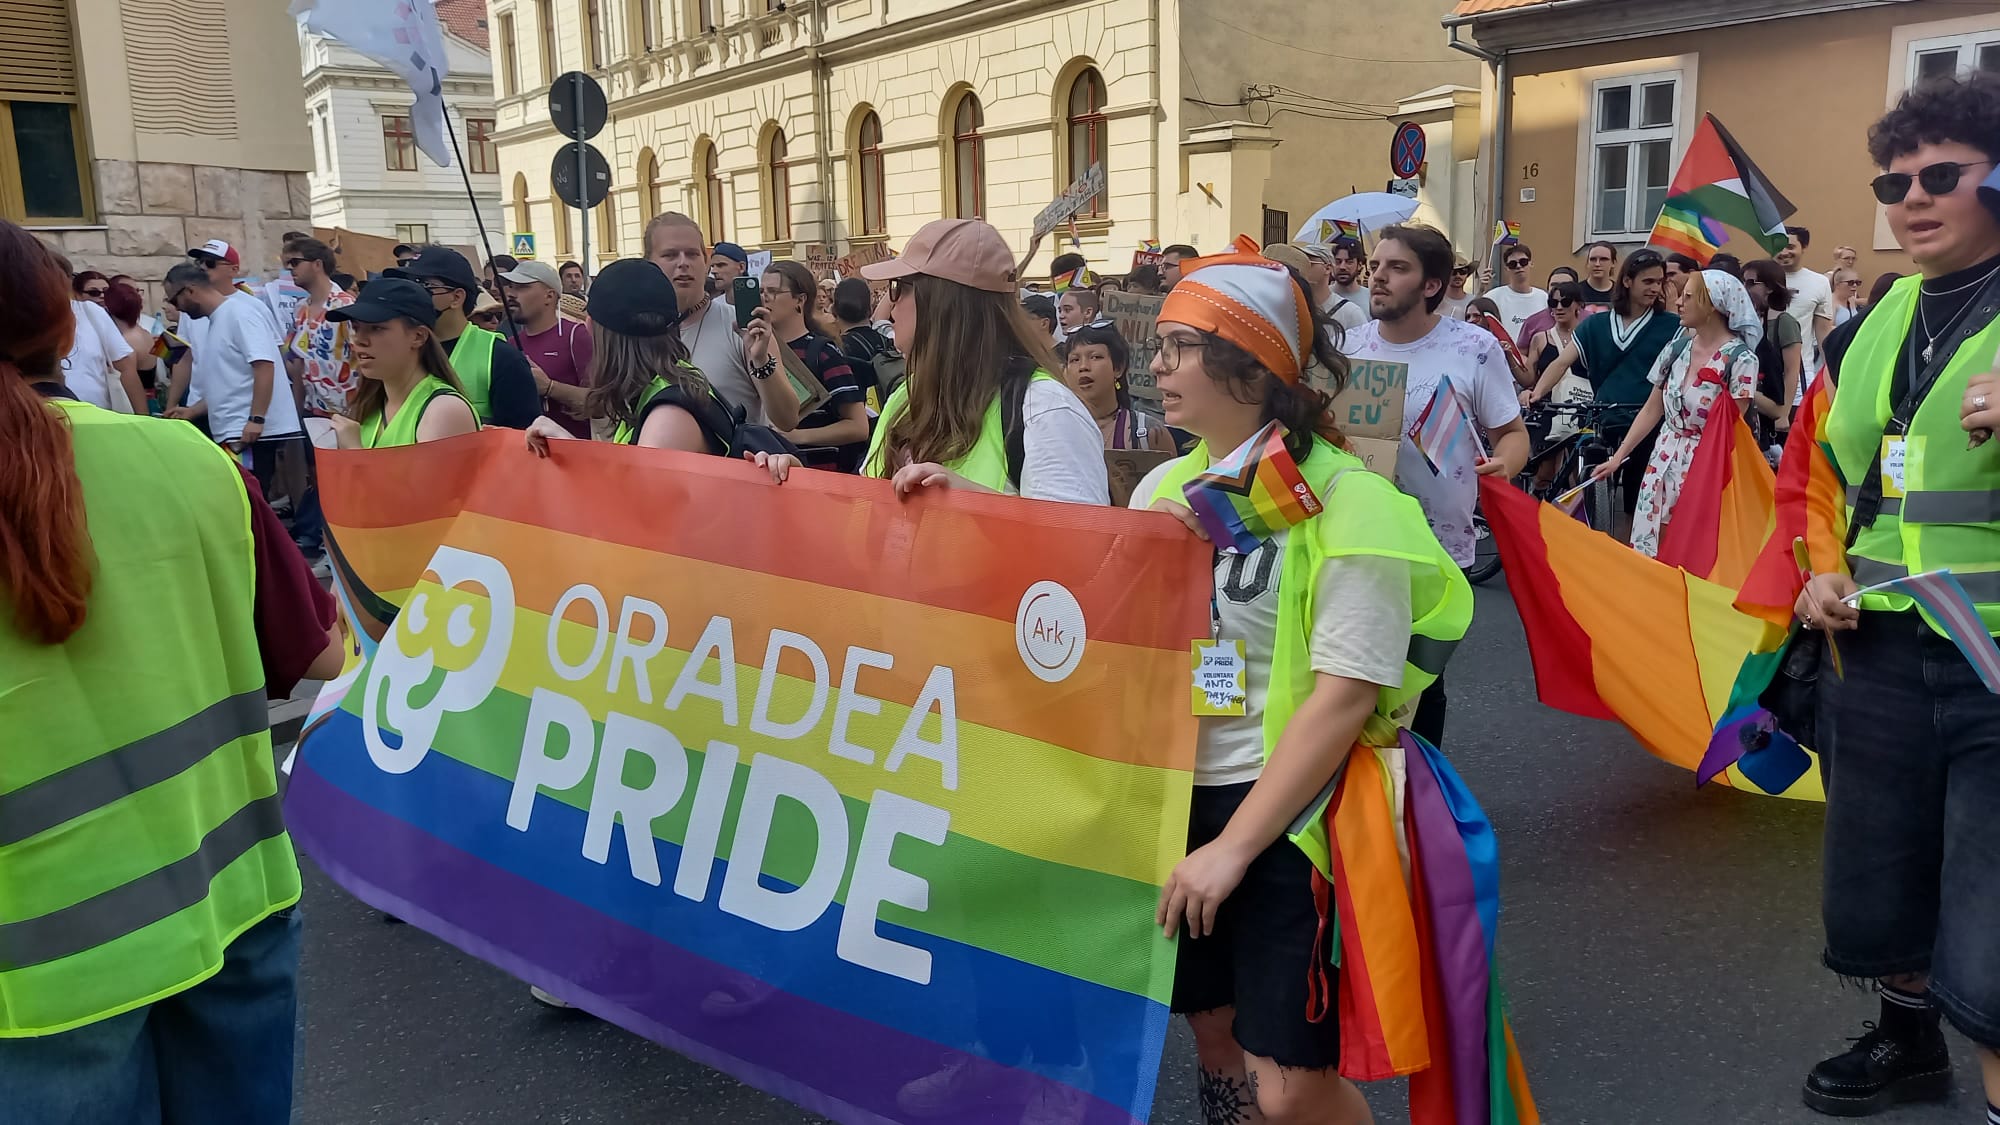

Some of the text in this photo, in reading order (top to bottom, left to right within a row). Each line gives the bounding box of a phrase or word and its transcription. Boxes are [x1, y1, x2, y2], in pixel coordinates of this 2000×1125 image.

[1522, 162, 1539, 180] 16
[1136, 252, 1153, 265] WE
[1032, 616, 1064, 646] Ark
[547, 583, 960, 791] ORADEA
[1204, 679, 1234, 689] ANTO
[505, 687, 951, 985] PRIDE
